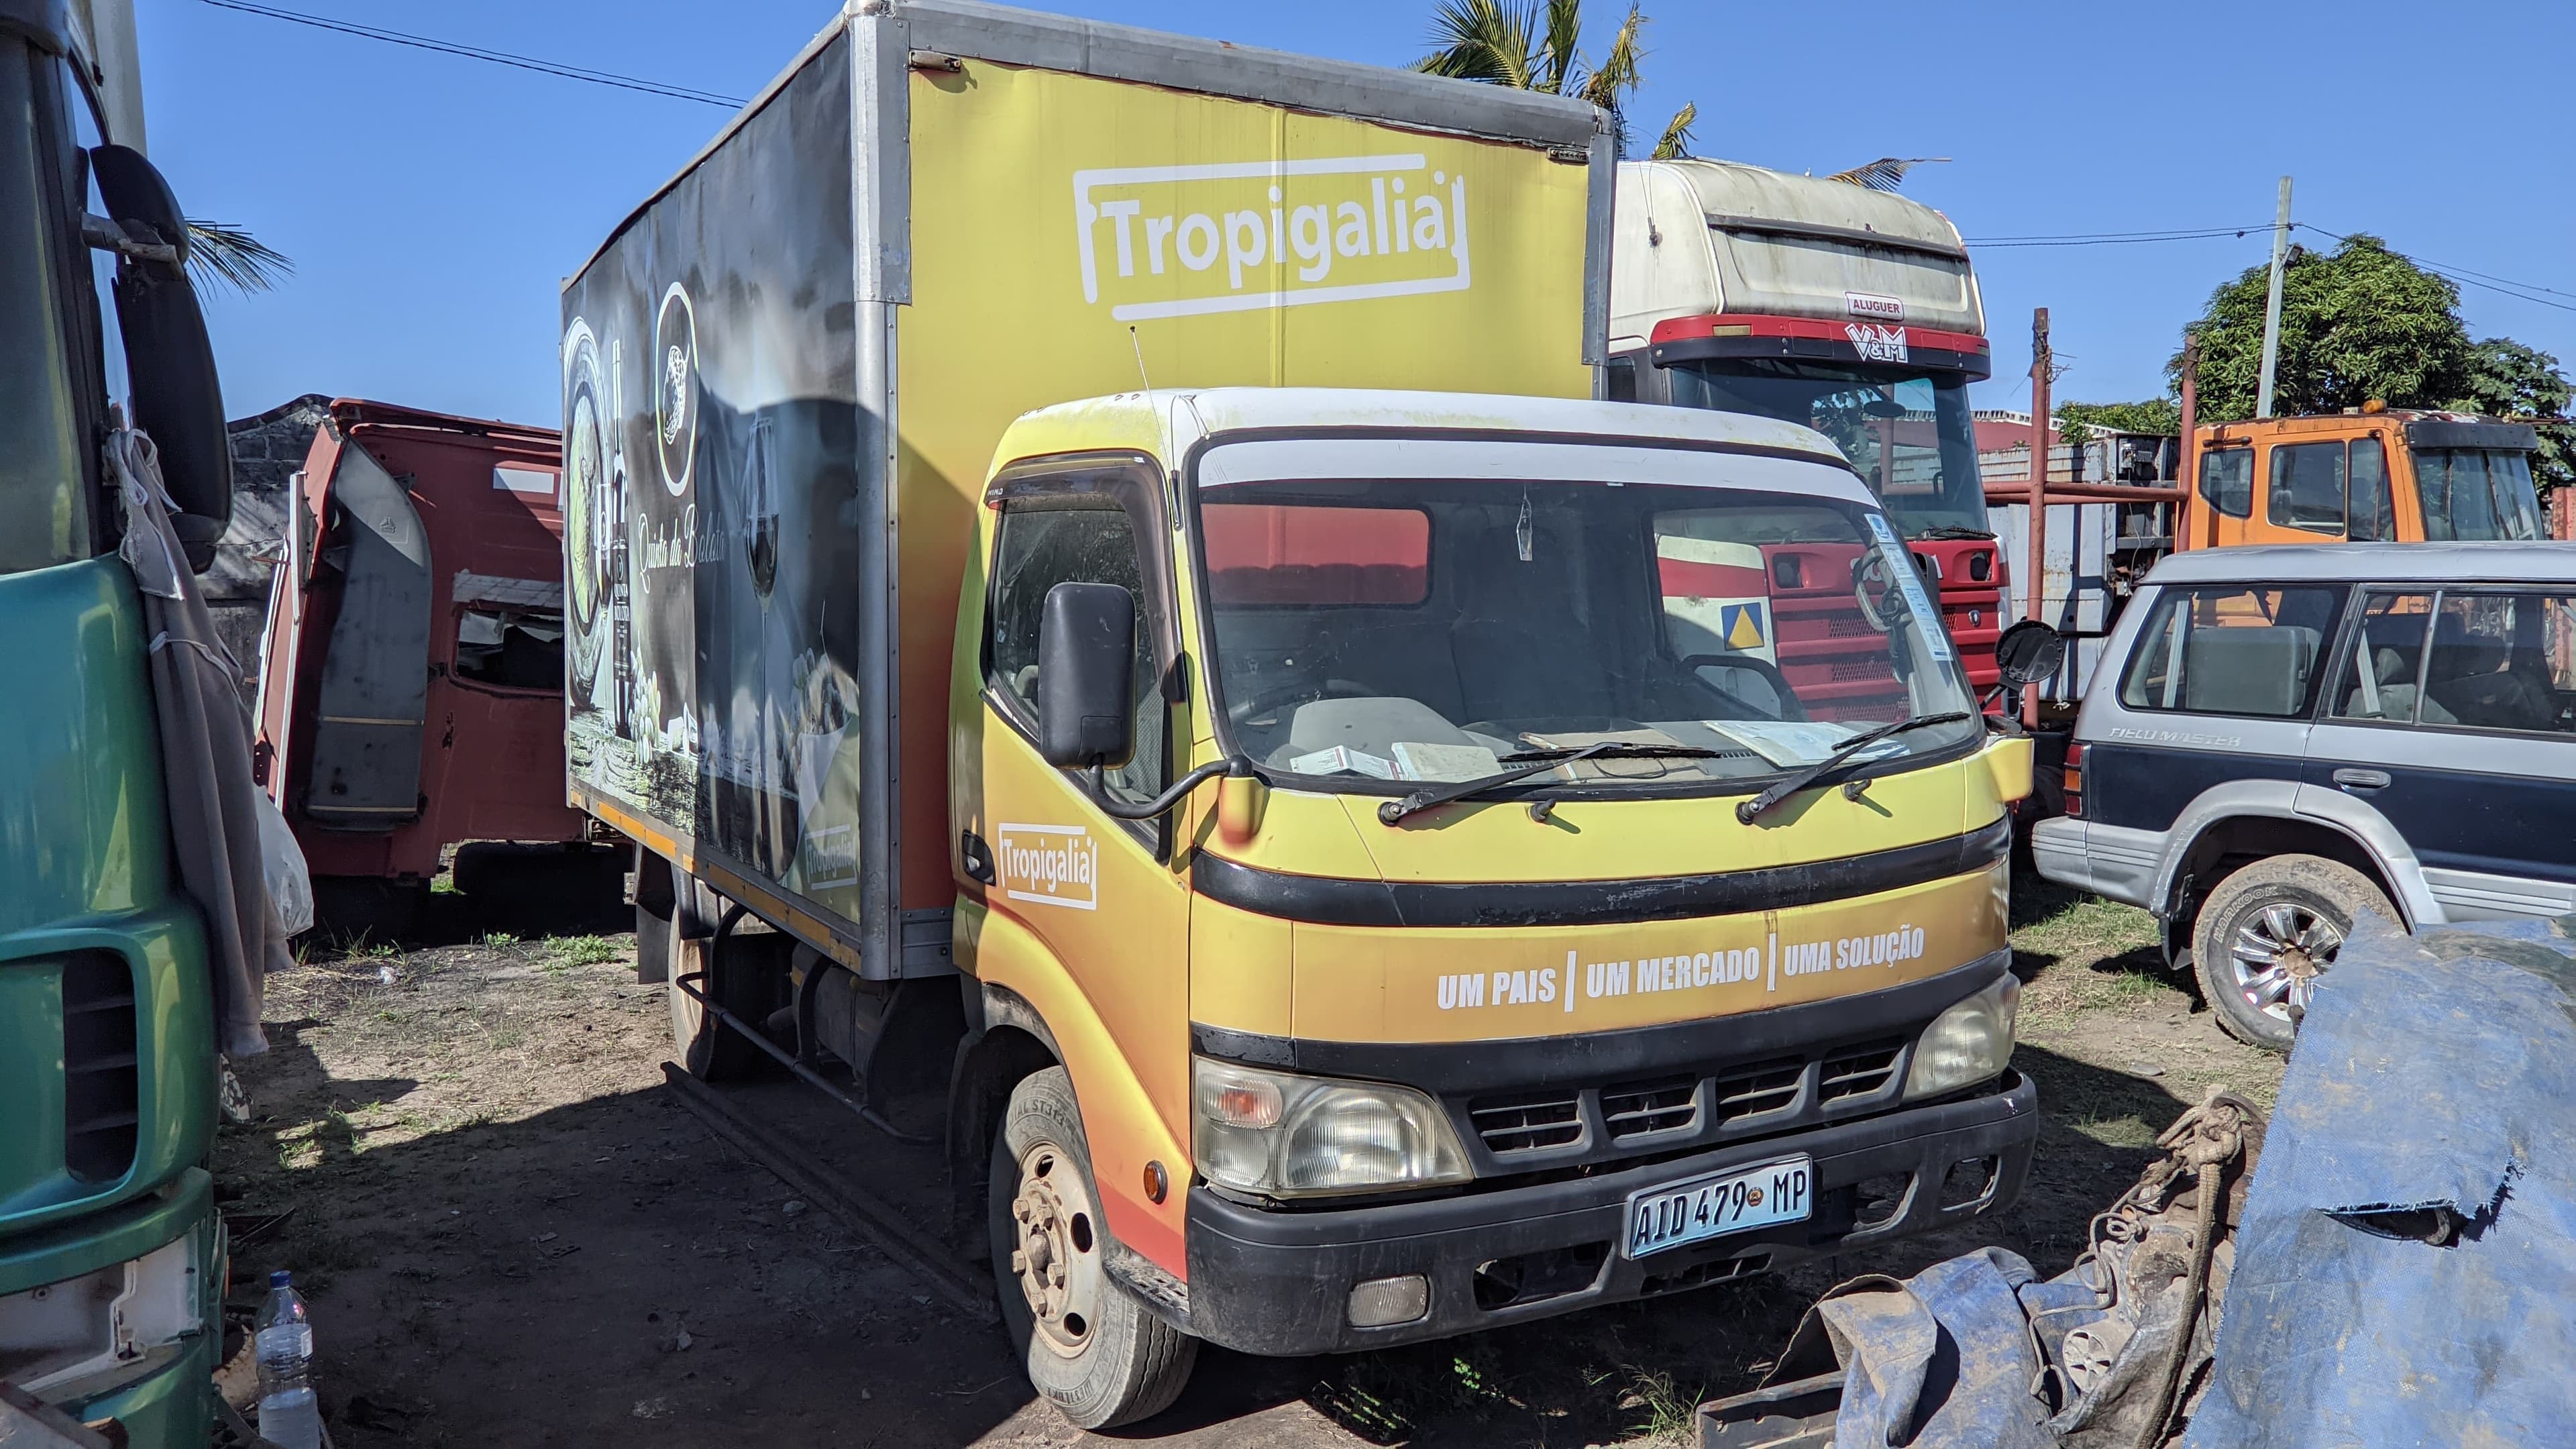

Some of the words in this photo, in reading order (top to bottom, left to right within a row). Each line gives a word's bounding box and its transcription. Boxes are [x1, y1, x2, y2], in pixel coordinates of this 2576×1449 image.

[1100, 176, 1447, 289] Tropigalia
[1853, 298, 1900, 314] ALUGUER
[1845, 323, 1908, 364] V&M
[1003, 837, 1090, 893] Tropigalia
[1438, 973, 1484, 1009] UM
[1492, 968, 1556, 1006] PAIS
[1586, 961, 1630, 998] UM
[1637, 946, 1760, 994] MERCADO
[1784, 941, 1831, 977] UMA
[1835, 923, 1925, 969] SOLUÇÃO
[1634, 1195, 1688, 1246] AID
[1693, 1180, 1747, 1228] 479
[1772, 1169, 1807, 1214] MP
